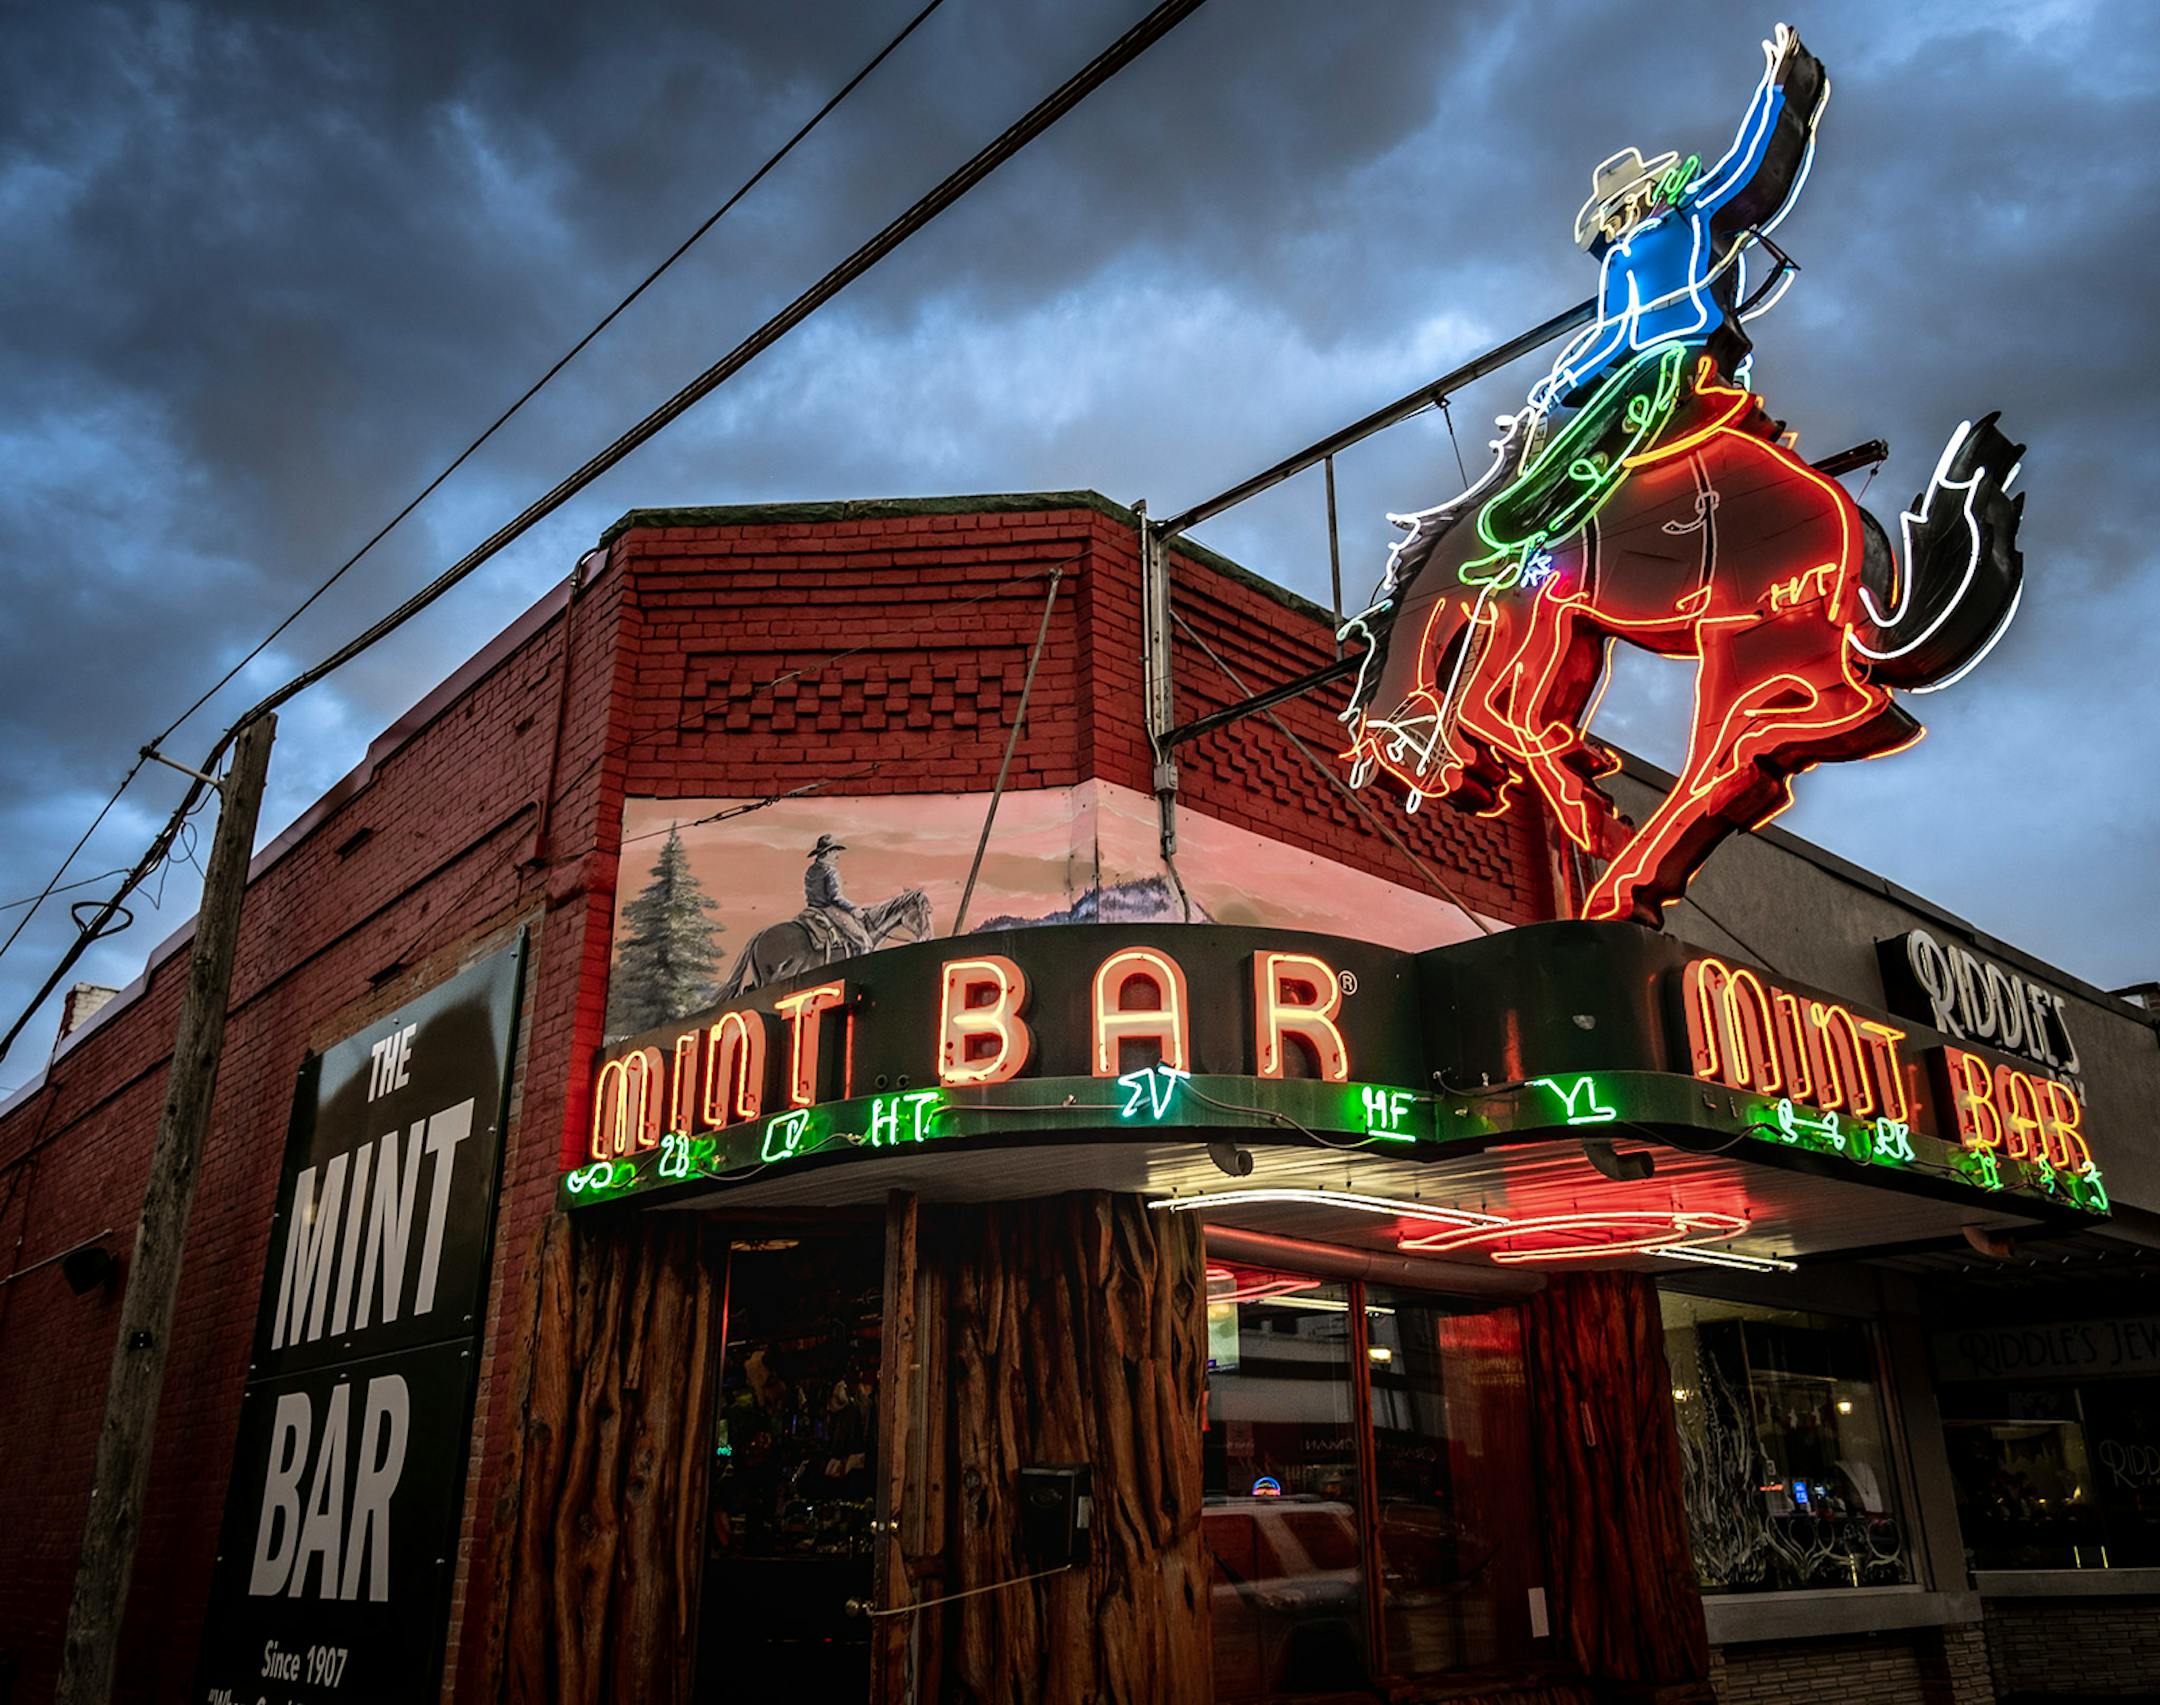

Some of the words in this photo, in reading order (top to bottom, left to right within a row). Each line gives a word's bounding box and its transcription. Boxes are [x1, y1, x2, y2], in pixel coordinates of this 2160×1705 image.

[367, 1023, 417, 1103] THE
[590, 979, 847, 1161] MINT
[1682, 957, 1907, 1125] MINT
[1943, 1043, 2094, 1178] BAR
[1906, 928, 2081, 1075] RIDDLE'S
[271, 1097, 475, 1351] MINT
[1959, 1324, 2097, 1376] RIDDLE'S
[248, 1373, 410, 1603] BAR
[261, 1639, 301, 1682] Since
[306, 1644, 349, 1689] 1907
